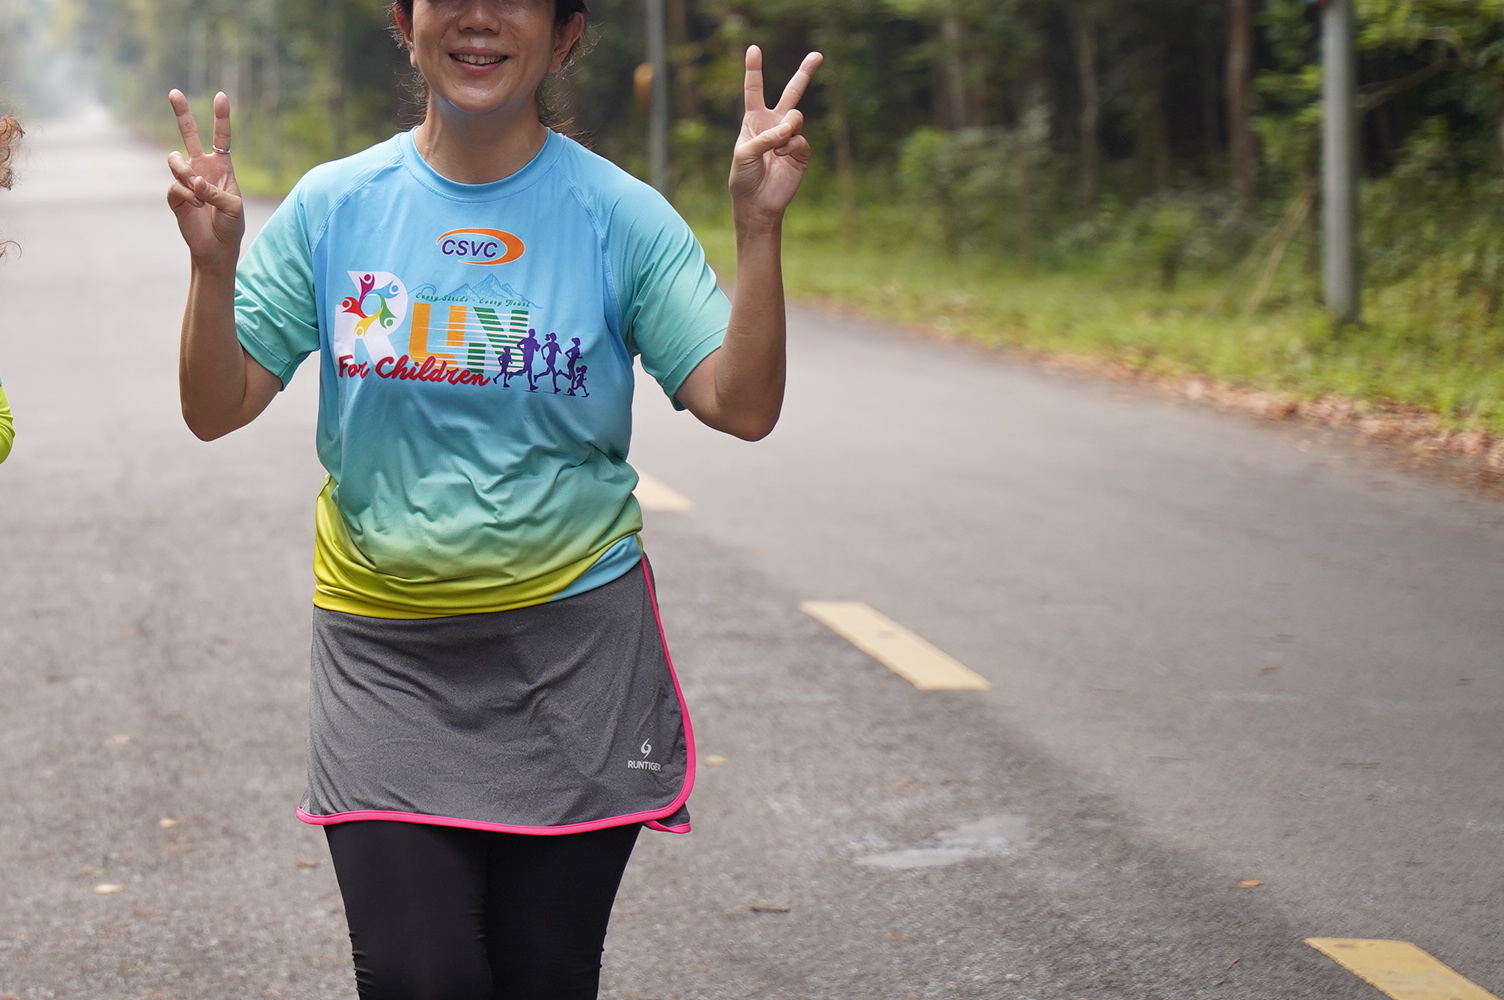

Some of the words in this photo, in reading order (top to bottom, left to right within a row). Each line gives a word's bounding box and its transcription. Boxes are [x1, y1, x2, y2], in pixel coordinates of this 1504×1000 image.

[441, 239, 498, 258] CSVC
[338, 354, 371, 379] For
[375, 354, 491, 387] Children
[628, 760, 661, 771] RUNTIGER
